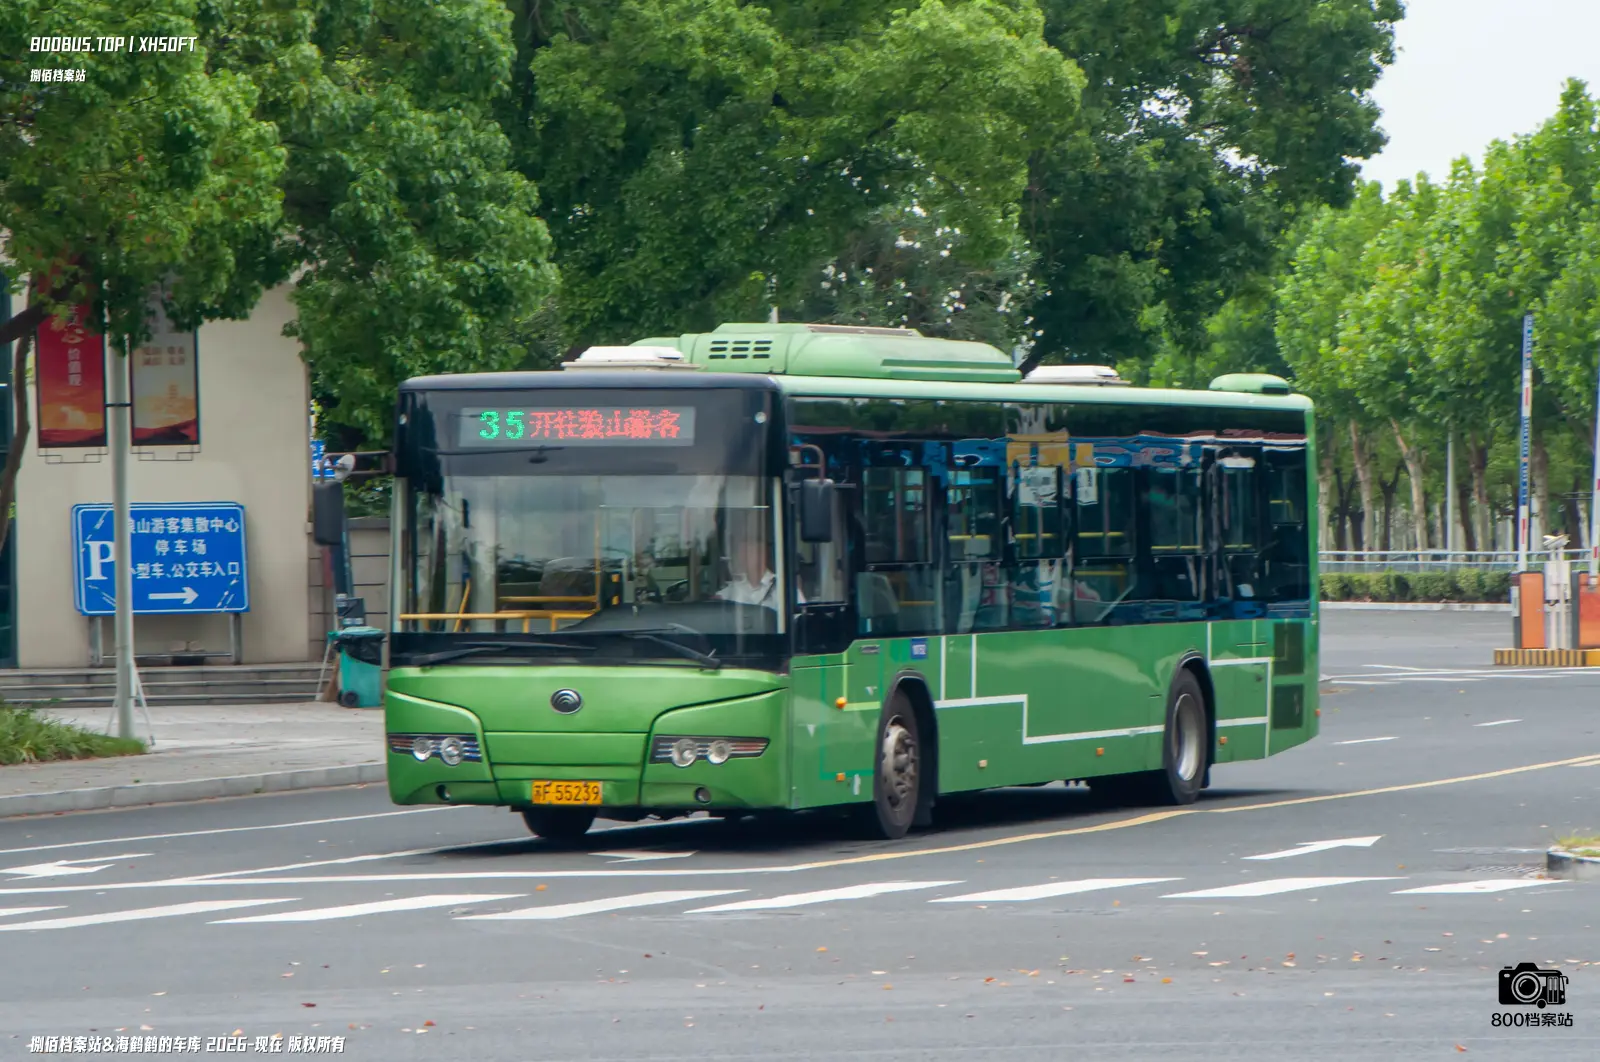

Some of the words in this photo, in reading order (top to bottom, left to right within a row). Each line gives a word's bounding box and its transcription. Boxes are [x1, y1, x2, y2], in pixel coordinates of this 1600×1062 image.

[479, 410, 525, 440] 35
[155, 540, 207, 556] 停车场
